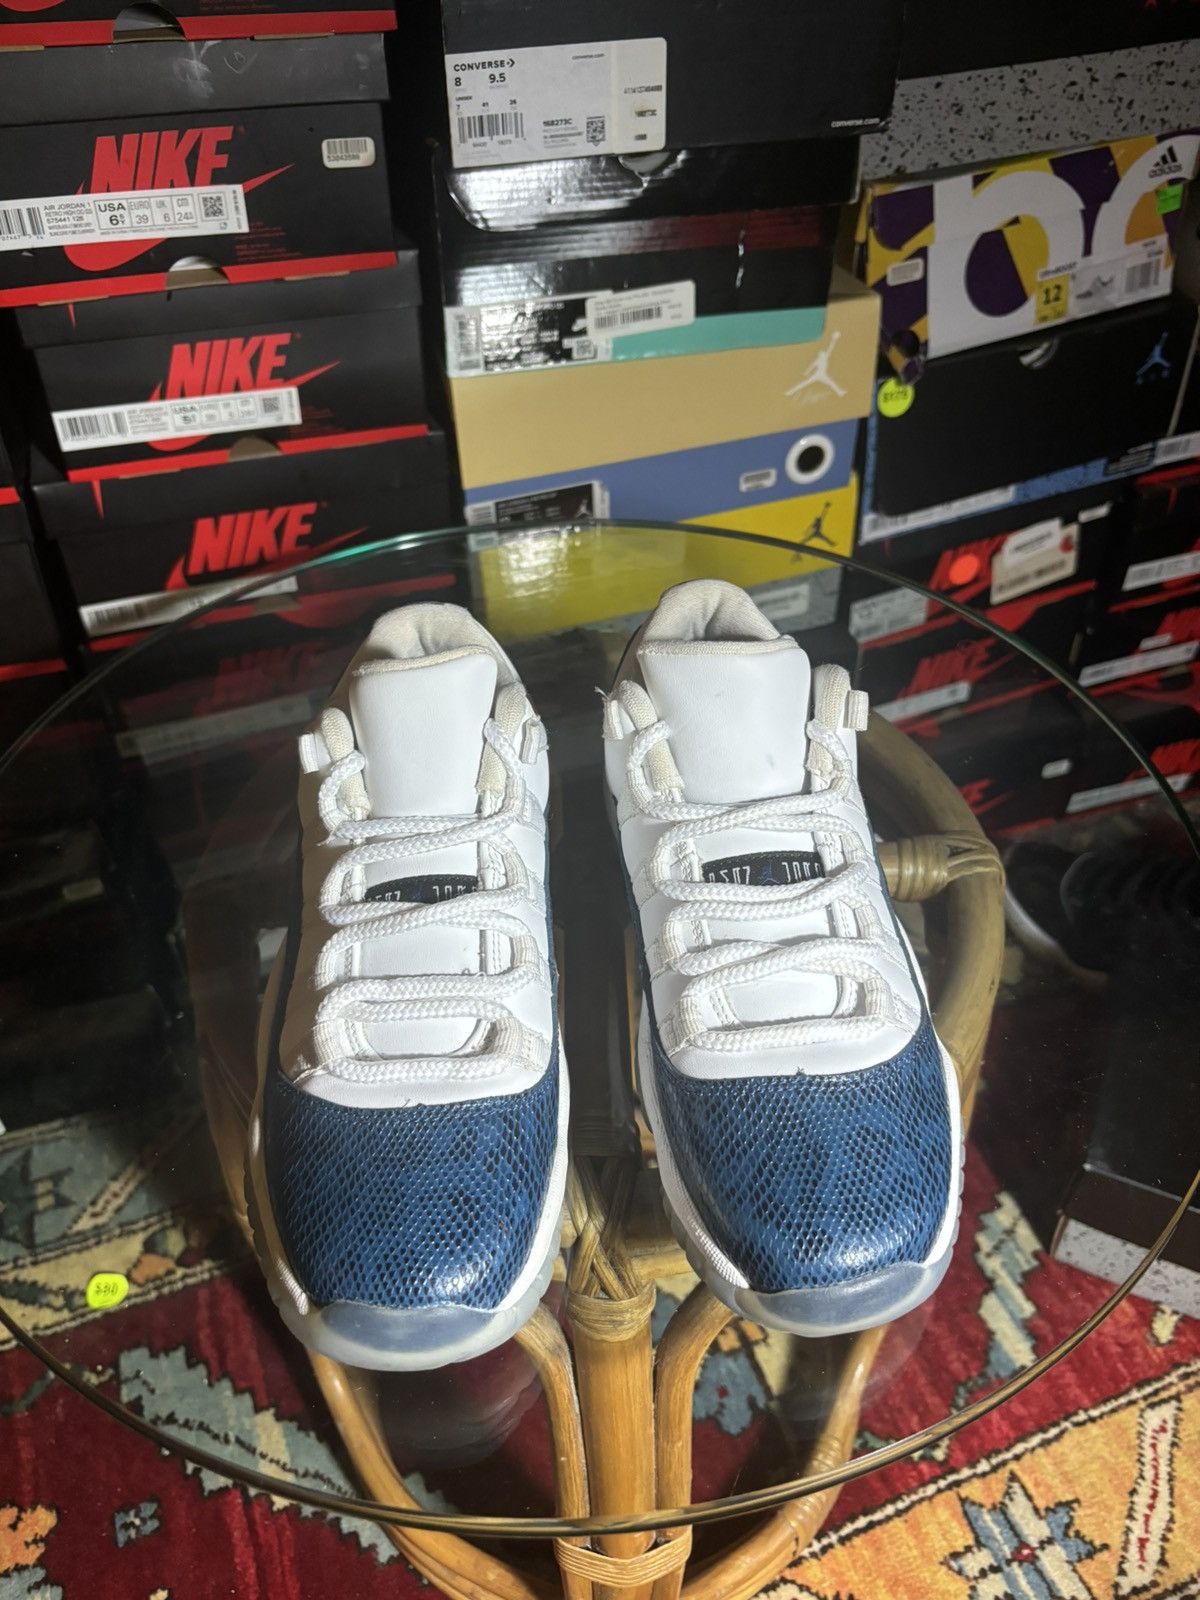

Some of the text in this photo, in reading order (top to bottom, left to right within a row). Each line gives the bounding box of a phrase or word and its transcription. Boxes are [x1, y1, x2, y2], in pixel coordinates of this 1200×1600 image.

[453, 59, 506, 72] CONVERSE
[454, 73, 506, 87] 8 9.5
[542, 117, 573, 127] 168273C
[830, 117, 881, 128] converse.com
[91, 126, 233, 194] NIKE
[1148, 163, 1182, 179] adidas
[98, 202, 126, 213] USA
[135, 214, 149, 225] 39
[163, 212, 171, 223] 6
[1043, 284, 1062, 306] 12
[165, 333, 291, 399] NIKE
[188, 502, 318, 576] NIKE
